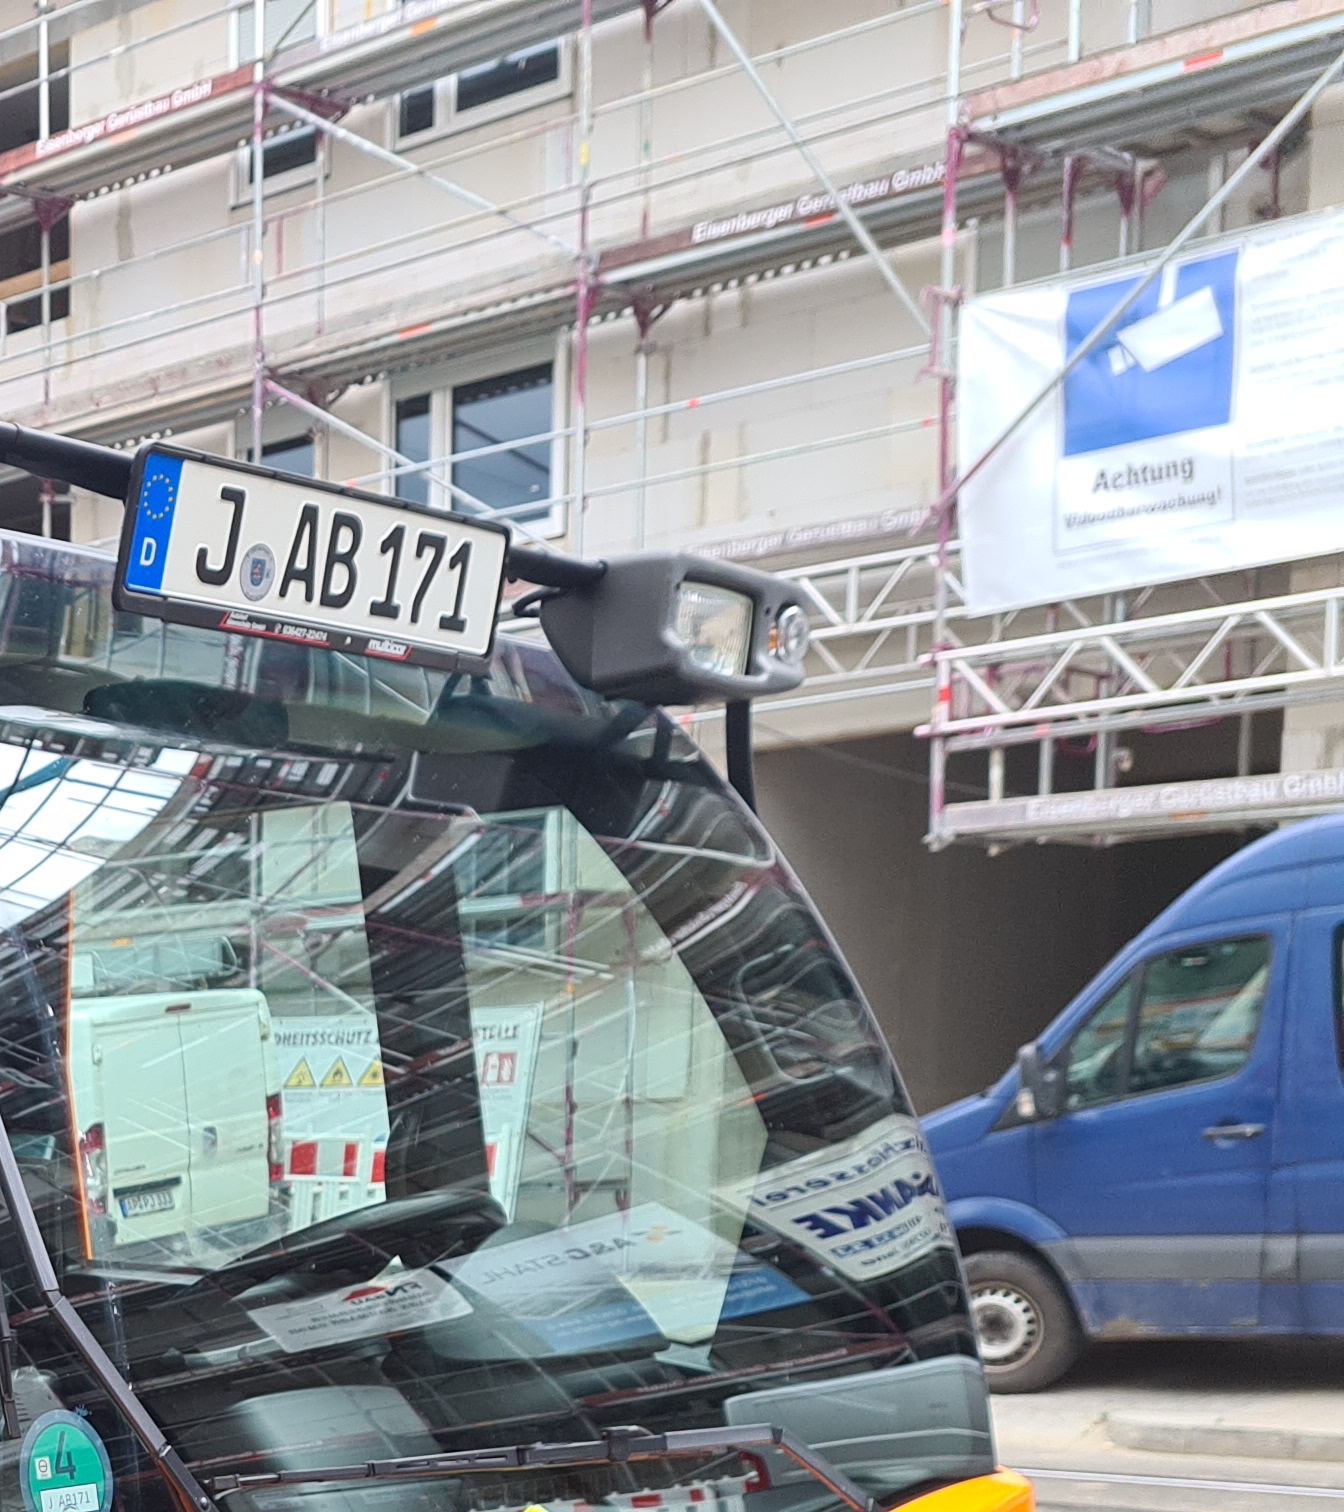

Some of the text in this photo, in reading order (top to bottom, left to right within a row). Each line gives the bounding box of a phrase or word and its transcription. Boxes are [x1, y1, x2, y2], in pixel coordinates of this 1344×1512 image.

[1092, 456, 1194, 493] Achtung
[139, 537, 157, 566] D
[195, 485, 247, 586] J
[54, 1430, 77, 1480] 4
[48, 1496, 54, 1510] J
